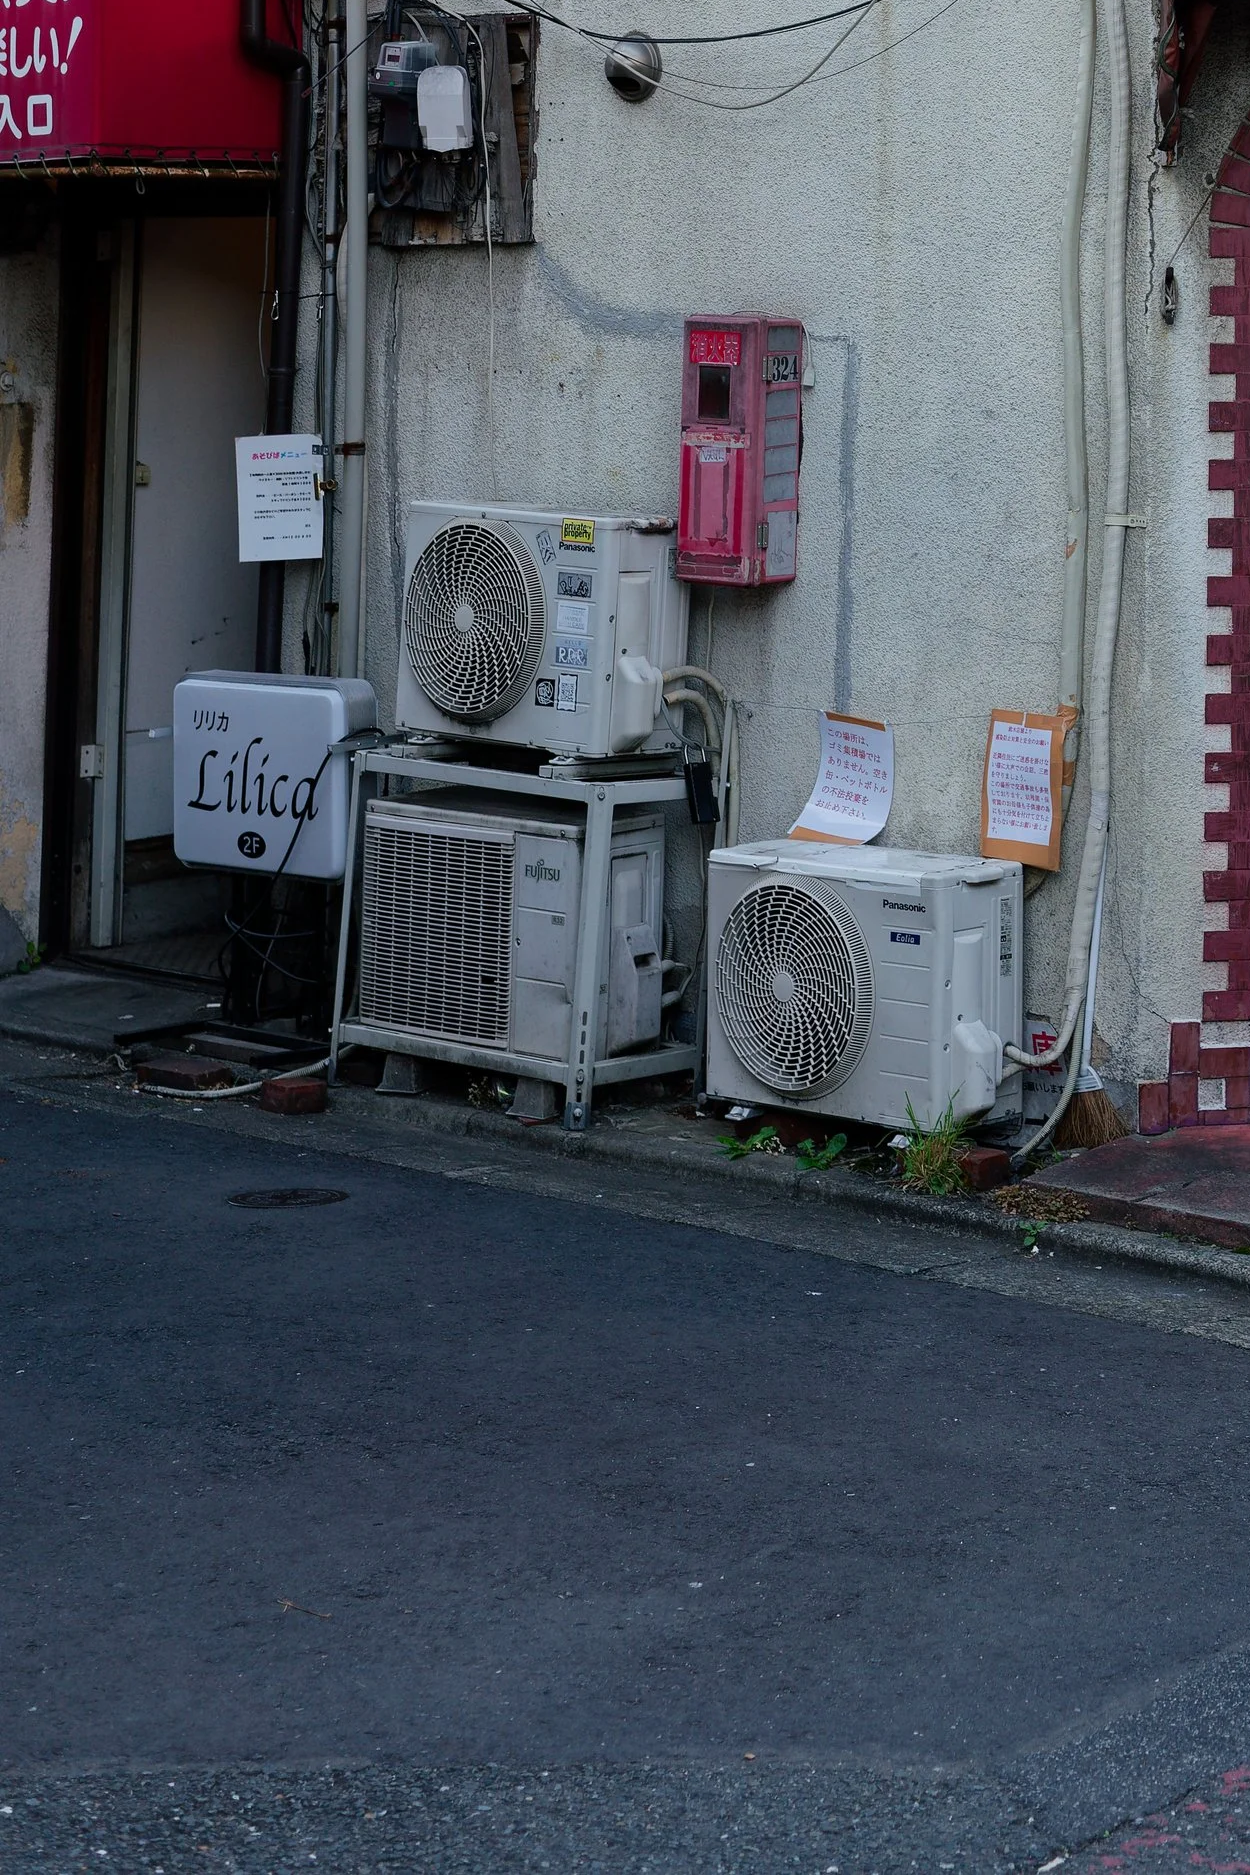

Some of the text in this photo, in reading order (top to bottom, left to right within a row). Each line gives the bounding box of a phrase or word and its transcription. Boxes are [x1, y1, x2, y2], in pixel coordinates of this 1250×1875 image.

[691, 332, 740, 363] 消火器
[772, 355, 799, 382] 324
[563, 529, 592, 541] property
[564, 522, 587, 532] private
[558, 541, 596, 554] Panasonic
[192, 709, 230, 733] リリカ
[187, 736, 319, 821] Lilica
[242, 835, 261, 854] 2F
[524, 858, 561, 883] FUJITSU
[882, 898, 927, 914] Panasonic
[895, 933, 915, 944] Eolia
